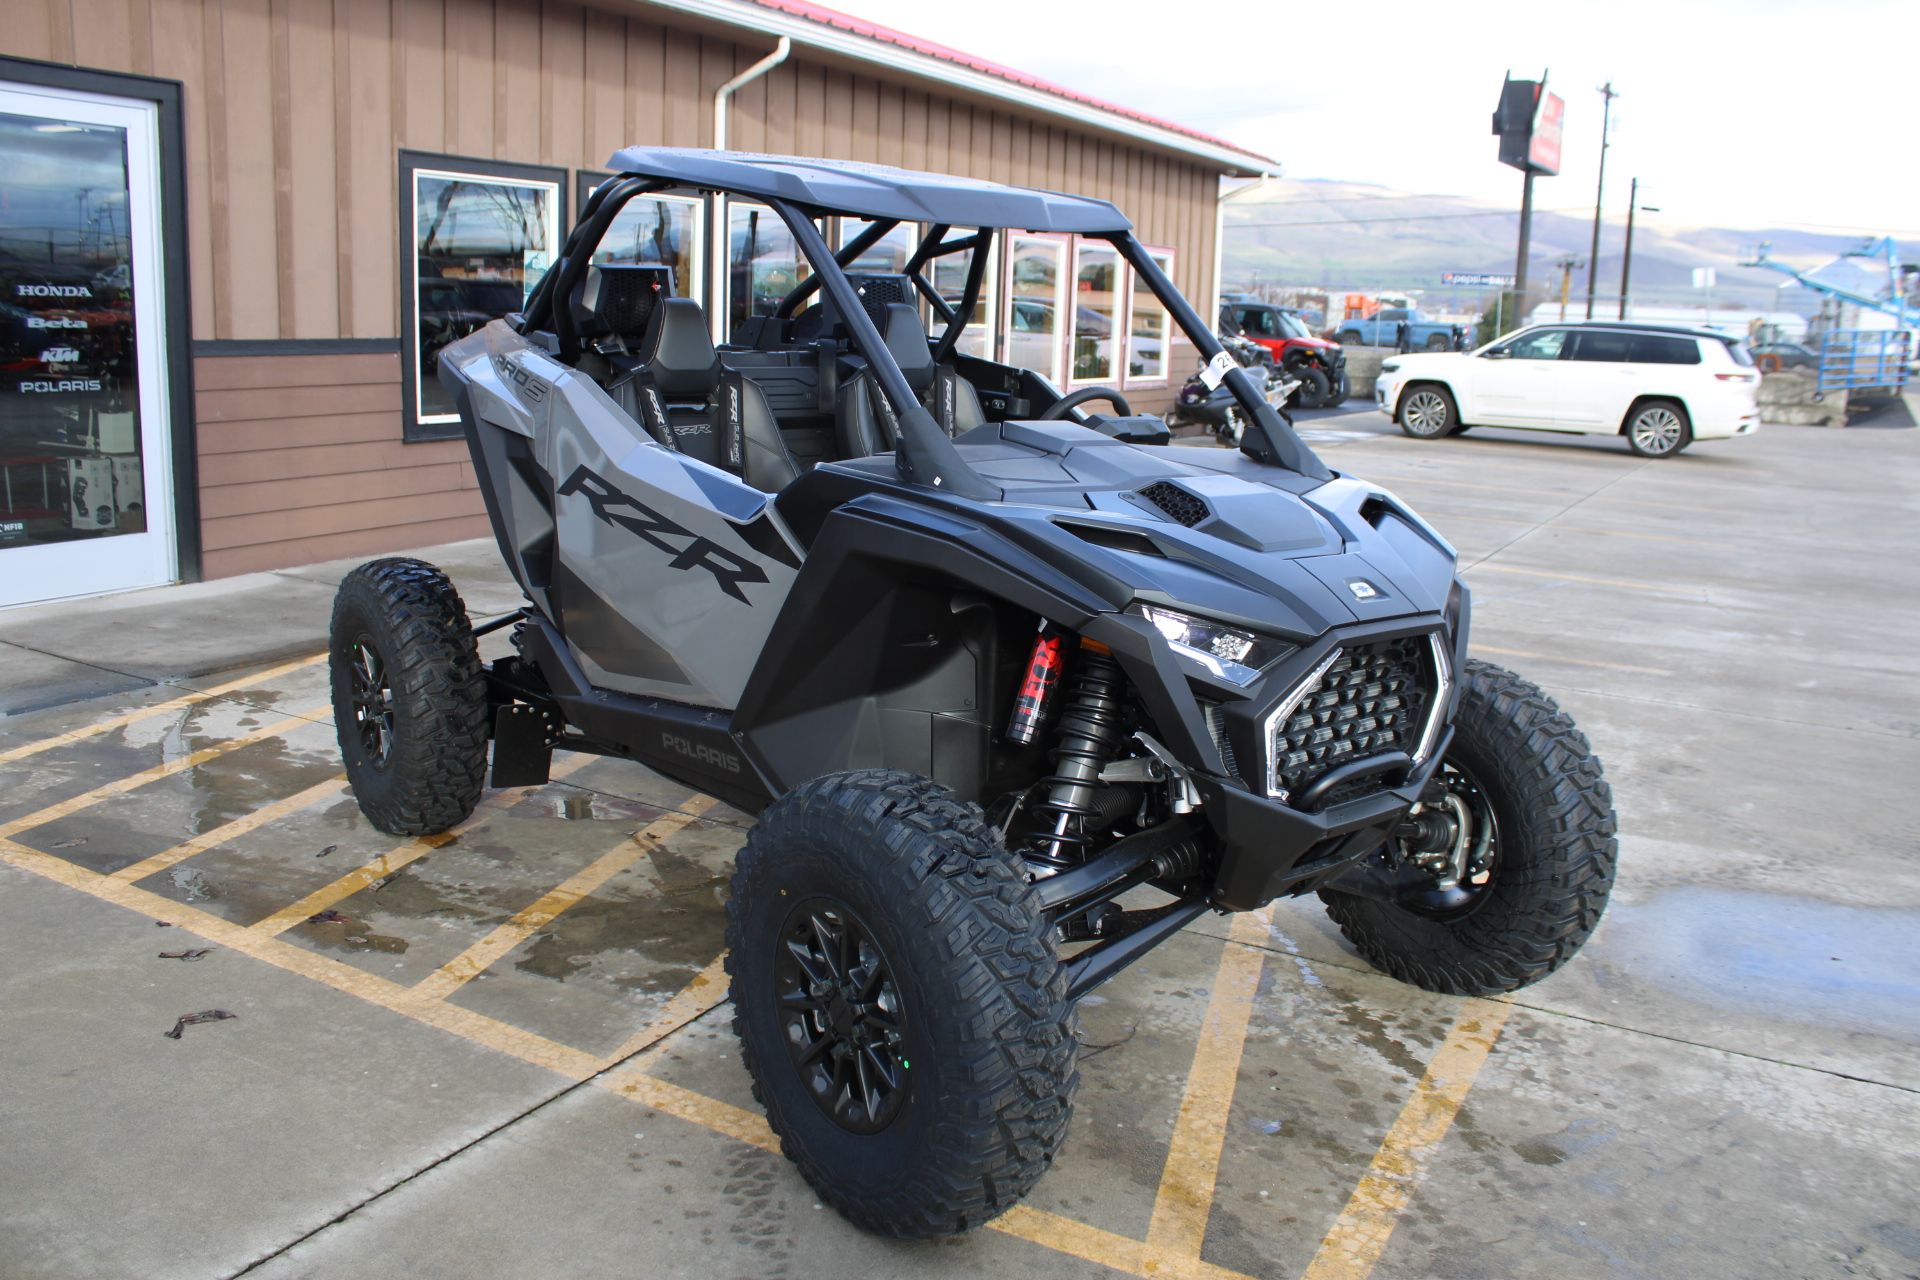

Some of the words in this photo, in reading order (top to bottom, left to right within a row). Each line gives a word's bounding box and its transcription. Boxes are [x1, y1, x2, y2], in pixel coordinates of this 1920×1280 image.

[18, 285, 93, 297] HONDA
[27, 316, 88, 329] Beta
[40, 347, 80, 362] KTM
[496, 353, 529, 387] PRO
[20, 380, 102, 393] POLARIS
[729, 385, 738, 422] RZR
[645, 388, 665, 425] RZR
[556, 464, 770, 608] RZR
[662, 732, 740, 773] POLARIS
